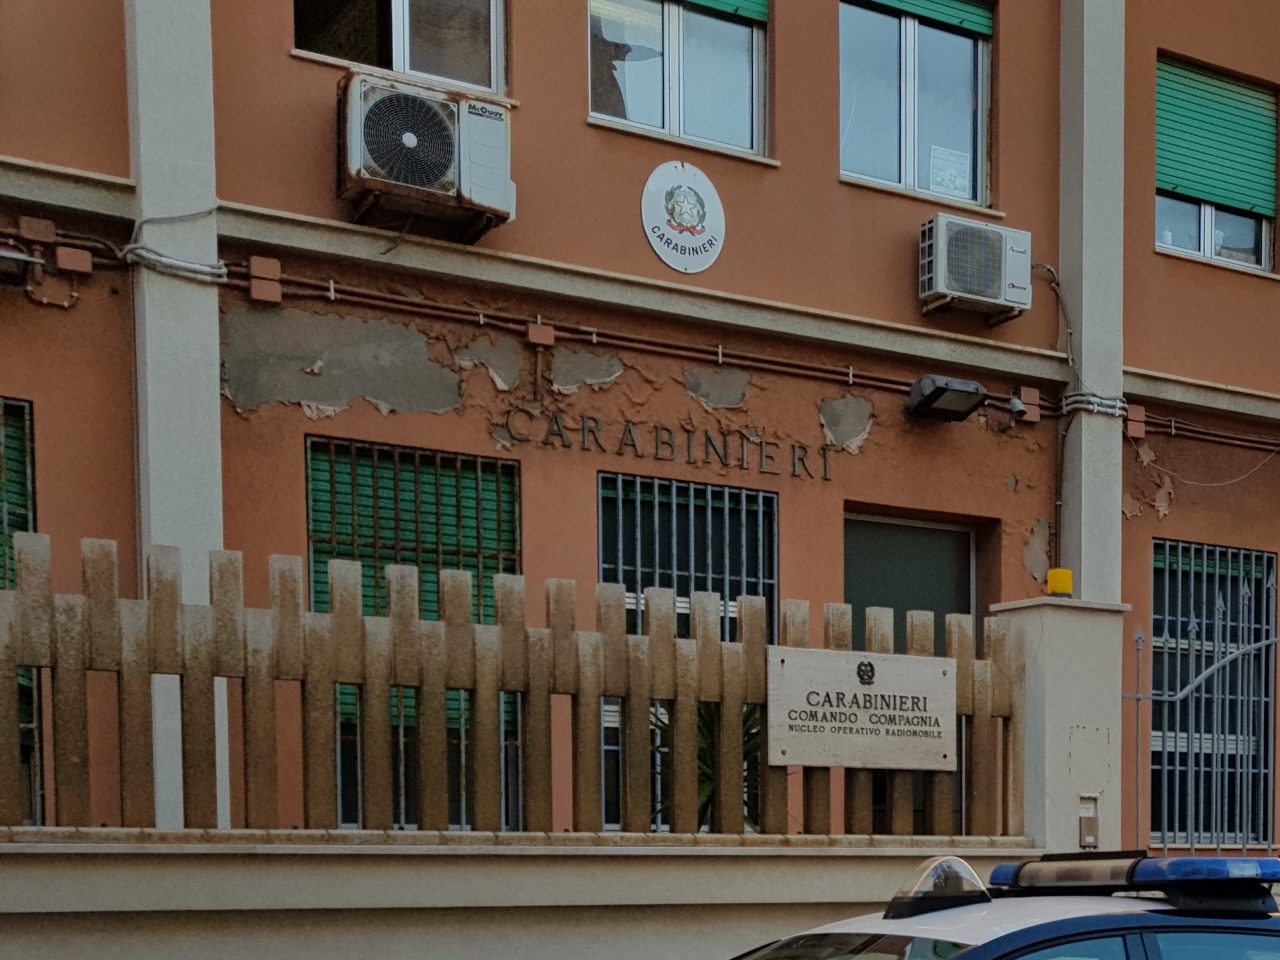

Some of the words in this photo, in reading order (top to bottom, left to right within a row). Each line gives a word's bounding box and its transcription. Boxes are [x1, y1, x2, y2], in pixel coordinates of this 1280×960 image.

[651, 225, 718, 256] CARABINIERI
[506, 407, 833, 481] CARABINIERI
[806, 691, 928, 713] CARABINIERI
[788, 709, 858, 724] COMANDO
[869, 713, 941, 728] COMPAGNIA
[788, 724, 826, 734] NUCLEO
[830, 726, 881, 736] OPERATIVO
[885, 728, 943, 739] RADIOMOBILE
